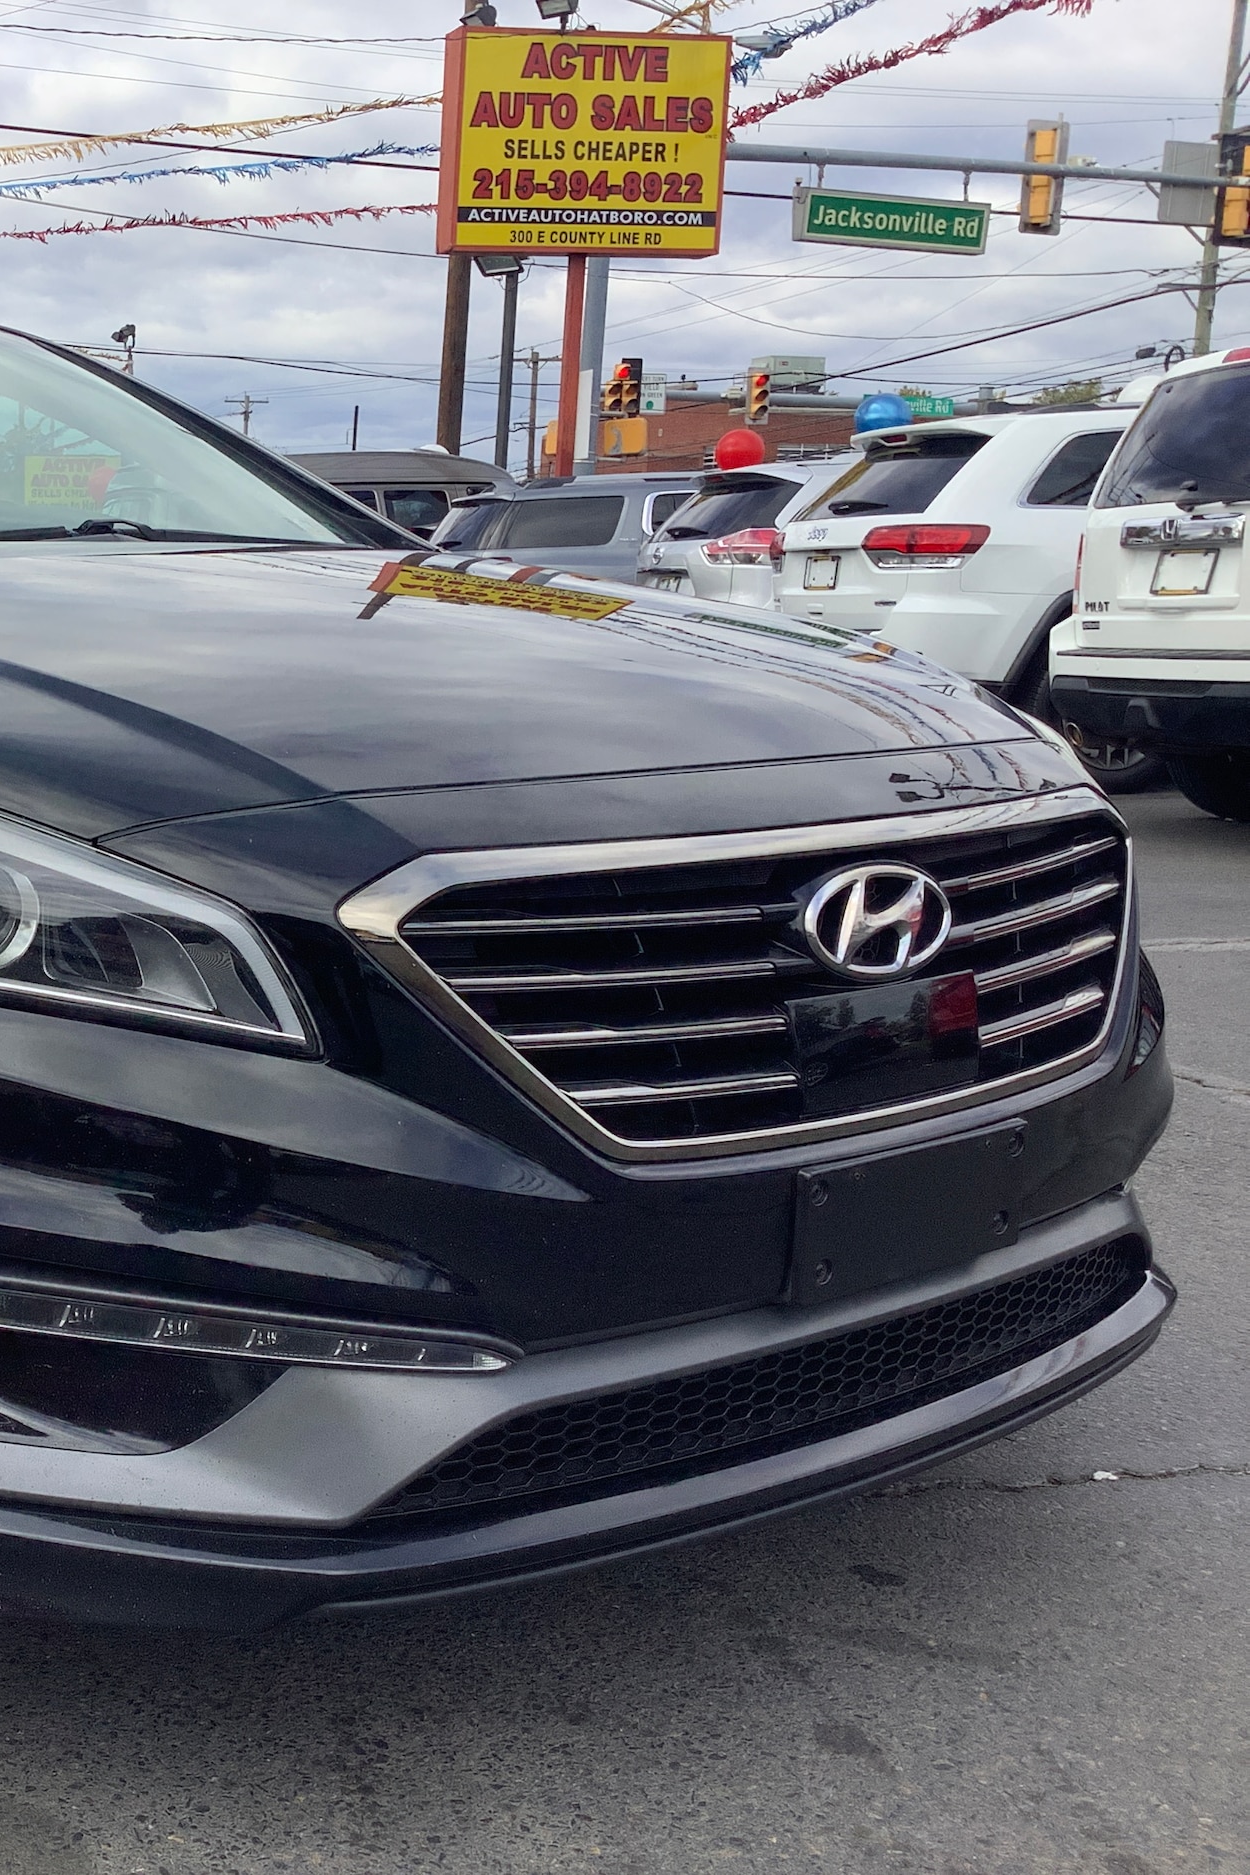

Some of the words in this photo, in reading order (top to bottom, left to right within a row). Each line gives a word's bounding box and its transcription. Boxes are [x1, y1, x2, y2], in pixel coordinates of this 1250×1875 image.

[520, 42, 670, 83] ACTIVE
[469, 91, 578, 130] AUTO
[591, 94, 714, 134] SALES
[504, 139, 566, 160] SELLS
[574, 140, 666, 162] CHEAPER
[472, 168, 704, 204] 215-394-8922
[467, 208, 703, 226] ACTIVEAUTOHATBORO.COM
[813, 205, 947, 236] Jacksonville
[952, 216, 979, 239] Rd
[510, 230, 533, 243] 300
[537, 231, 545, 244] E
[550, 231, 604, 245] COUNTY
[609, 232, 640, 245] LINE
[644, 232, 662, 245] RD
[31, 474, 70, 487] AUTO
[31, 489, 62, 498] SELLS
